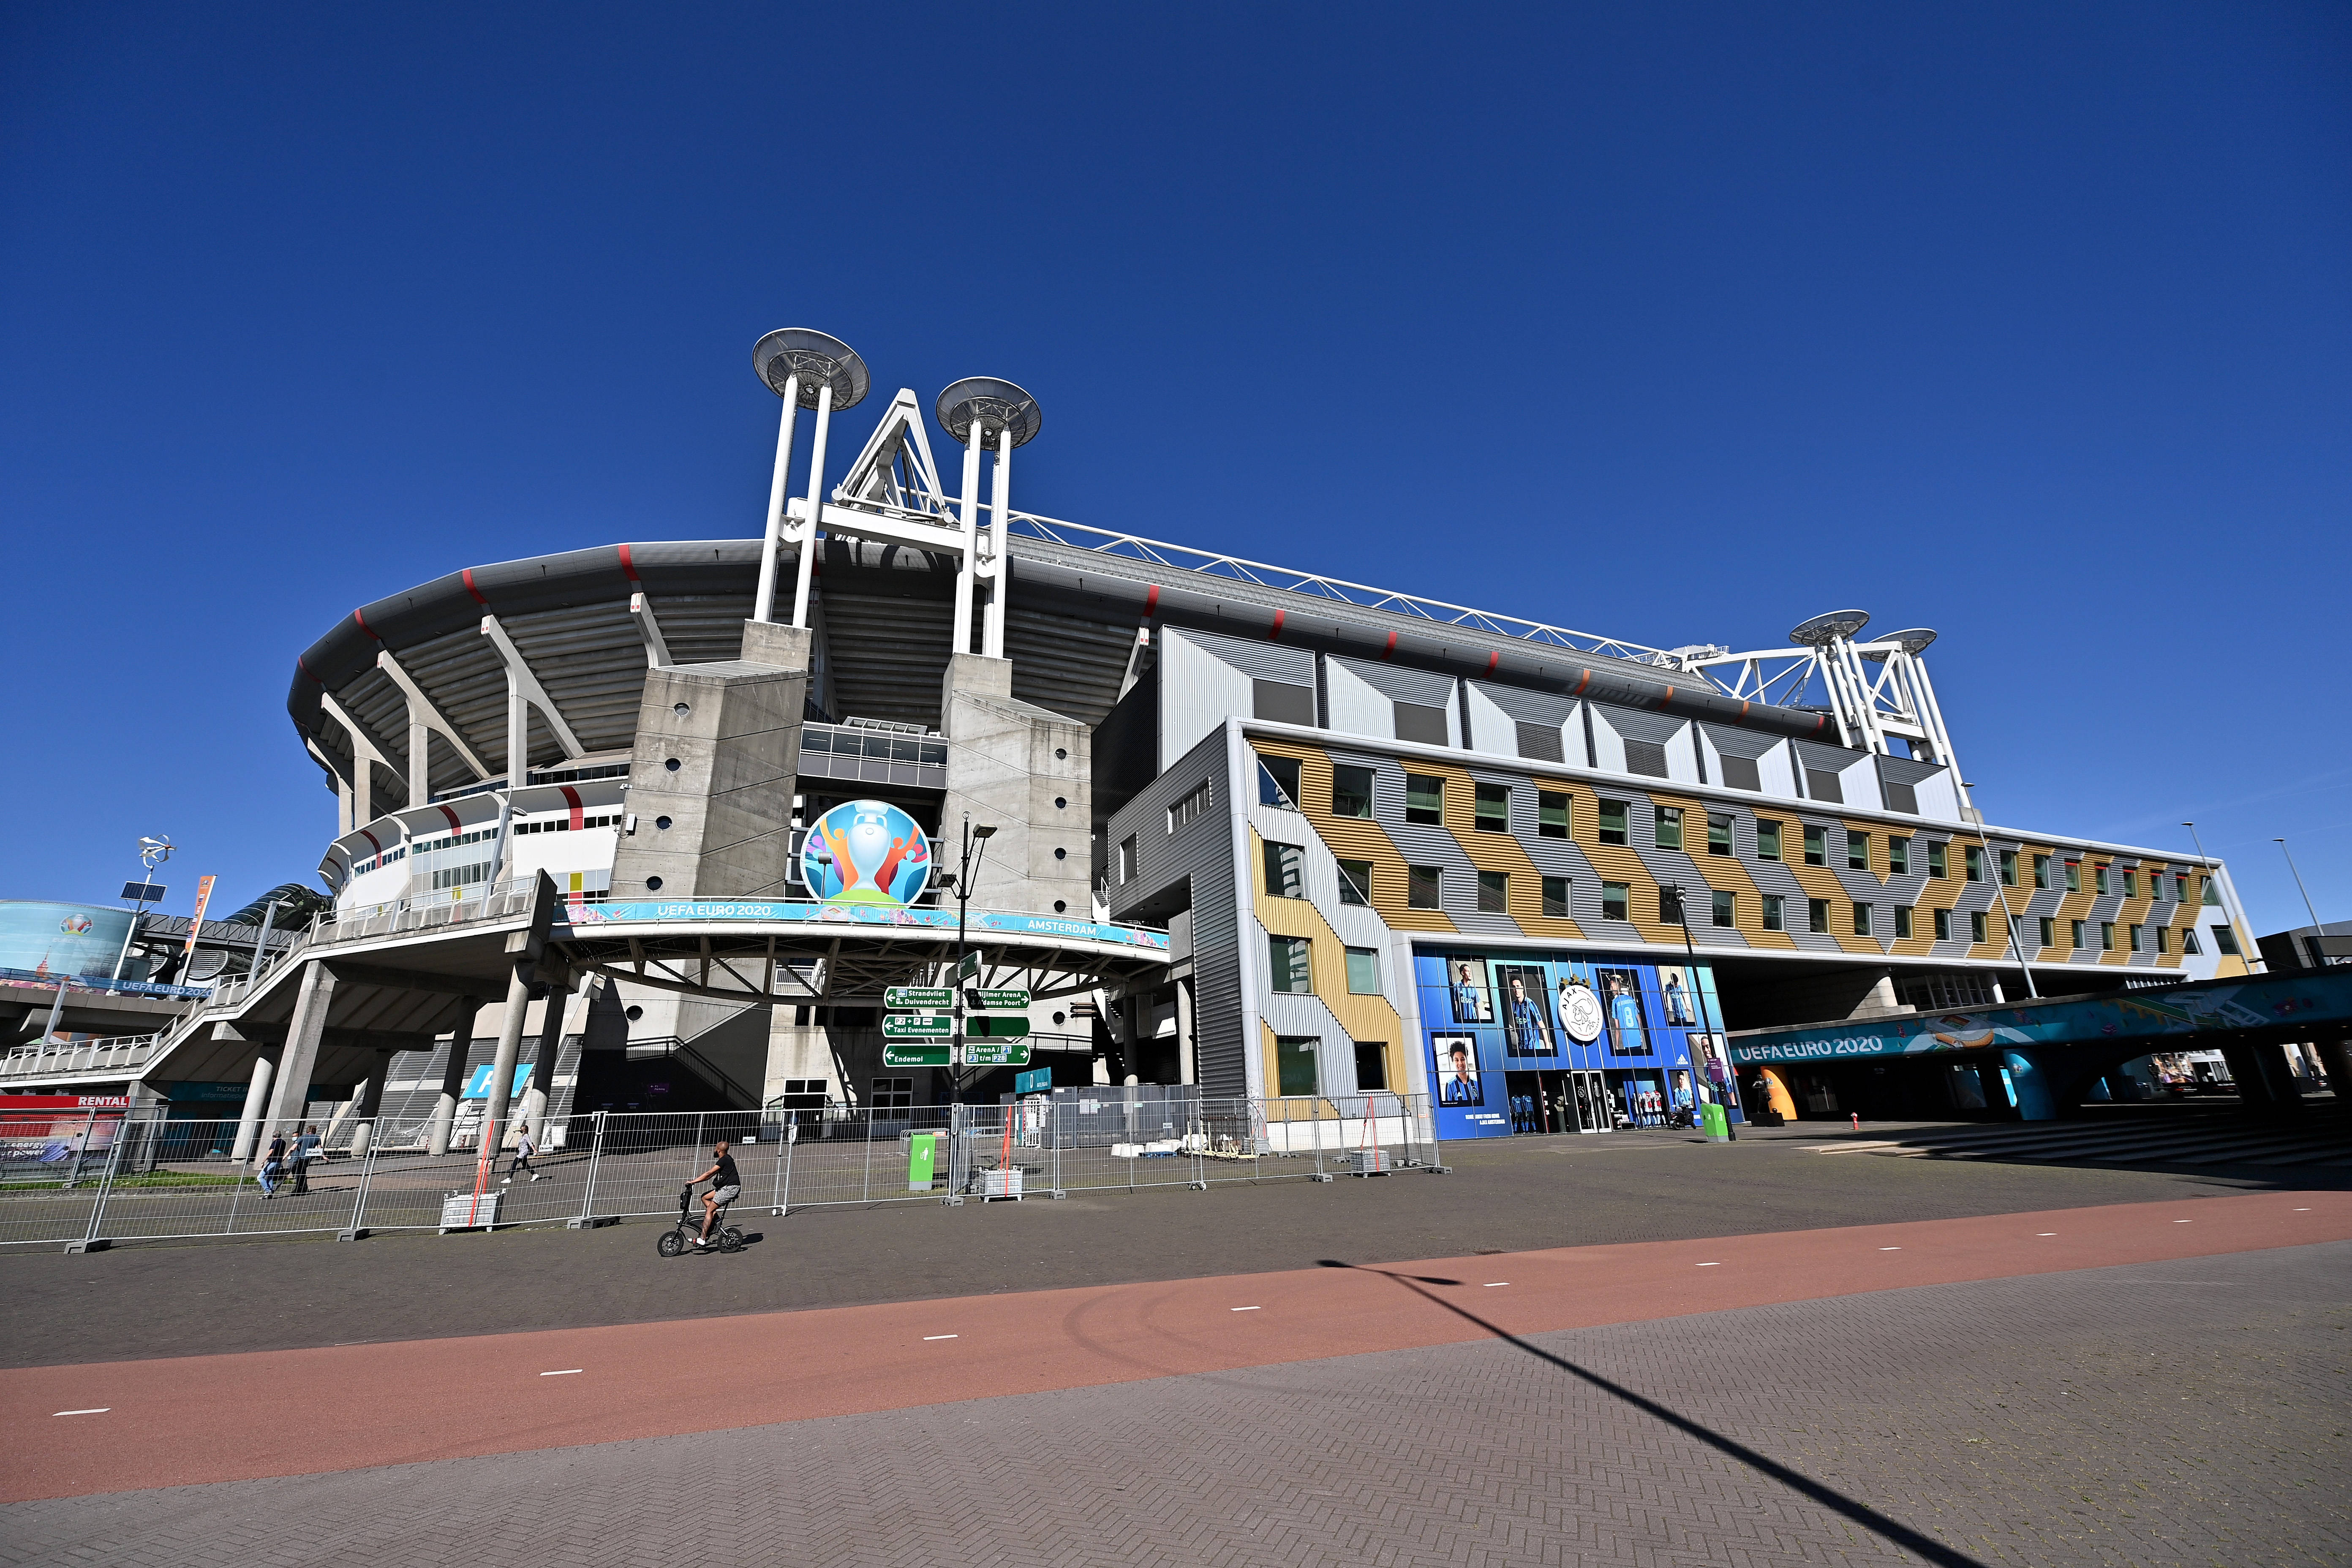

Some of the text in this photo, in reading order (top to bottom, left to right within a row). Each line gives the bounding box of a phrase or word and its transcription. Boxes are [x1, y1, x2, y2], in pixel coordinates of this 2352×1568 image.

[658, 905, 771, 915] UEFA EURO 2020
[1028, 920, 1096, 936] AMSTERDAM
[122, 981, 213, 996] UEFA EURO 2020
[1563, 988, 1577, 1010] AJAX
[1624, 1007, 1634, 1027] 8
[1738, 1035, 1883, 1061] UEFA EURO 2020
[1030, 1074, 1034, 1089] D
[78, 1097, 127, 1106] RENTAL
